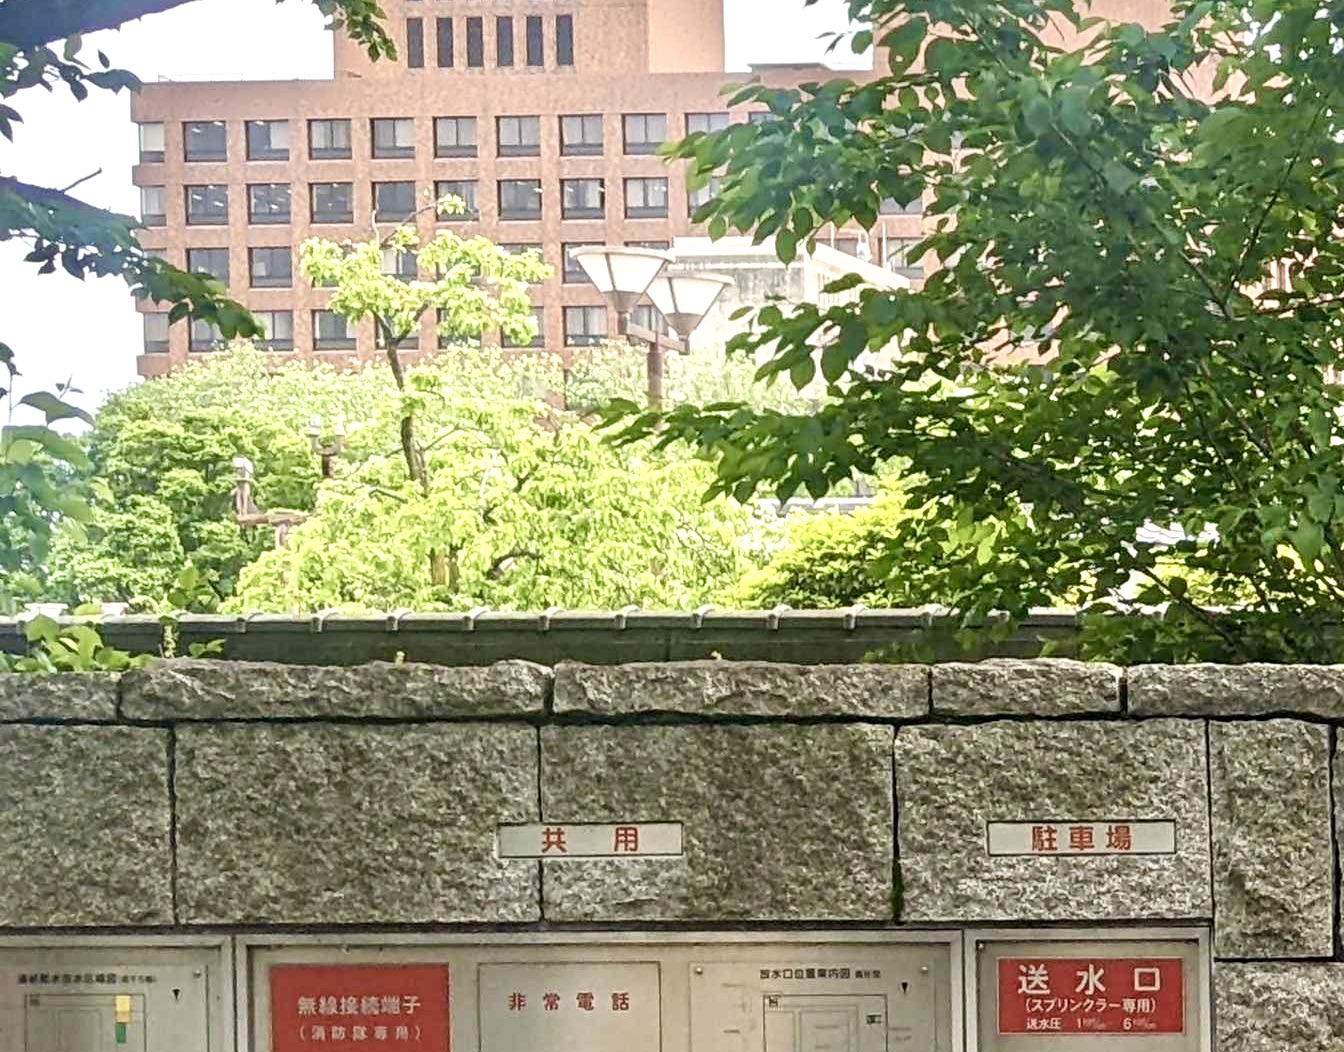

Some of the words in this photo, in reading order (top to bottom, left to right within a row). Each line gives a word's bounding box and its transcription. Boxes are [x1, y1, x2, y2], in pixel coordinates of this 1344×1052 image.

[541, 827, 638, 853] 共用
[1032, 825, 1132, 851] 駐車場
[1018, 964, 1161, 995] 送水口
[298, 996, 421, 1016] 無線接続端子
[509, 992, 630, 1011] 非常電話
[1025, 998, 1156, 1014] (スプリンクラー専用)
[1027, 1017, 1062, 1030] 送水圧
